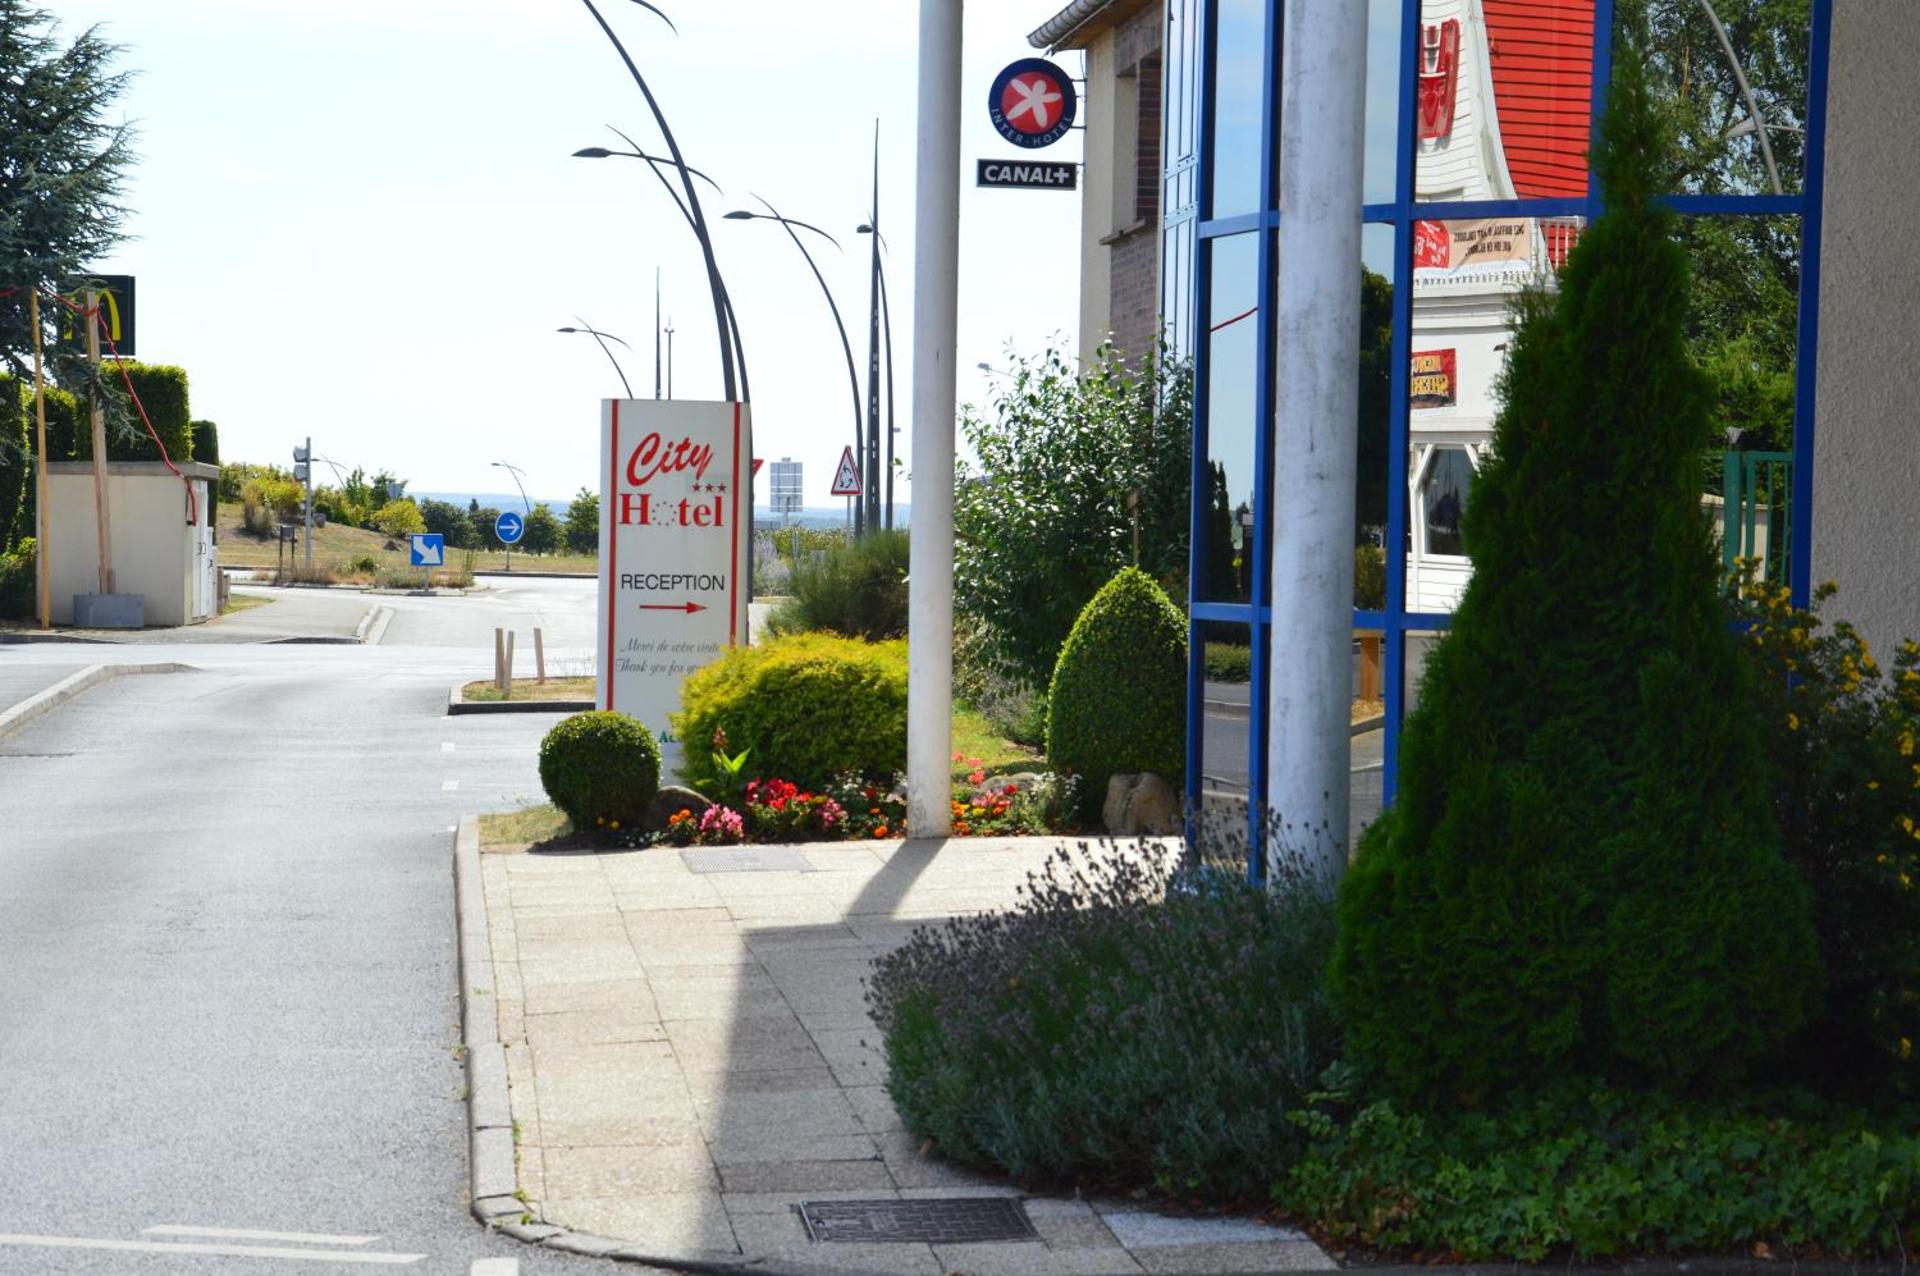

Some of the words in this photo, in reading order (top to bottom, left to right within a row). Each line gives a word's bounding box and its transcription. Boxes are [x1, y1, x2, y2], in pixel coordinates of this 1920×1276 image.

[991, 108, 1023, 143] INTER
[1032, 116, 1073, 147] HOTEL
[984, 165, 1070, 184] CANAL+
[626, 432, 714, 487] City
[620, 573, 725, 591] RECEPTION
[619, 637, 655, 653] Merci
[656, 639, 669, 653] de
[616, 658, 648, 673] Thank
[650, 664, 667, 676] you
[667, 660, 683, 677] for
